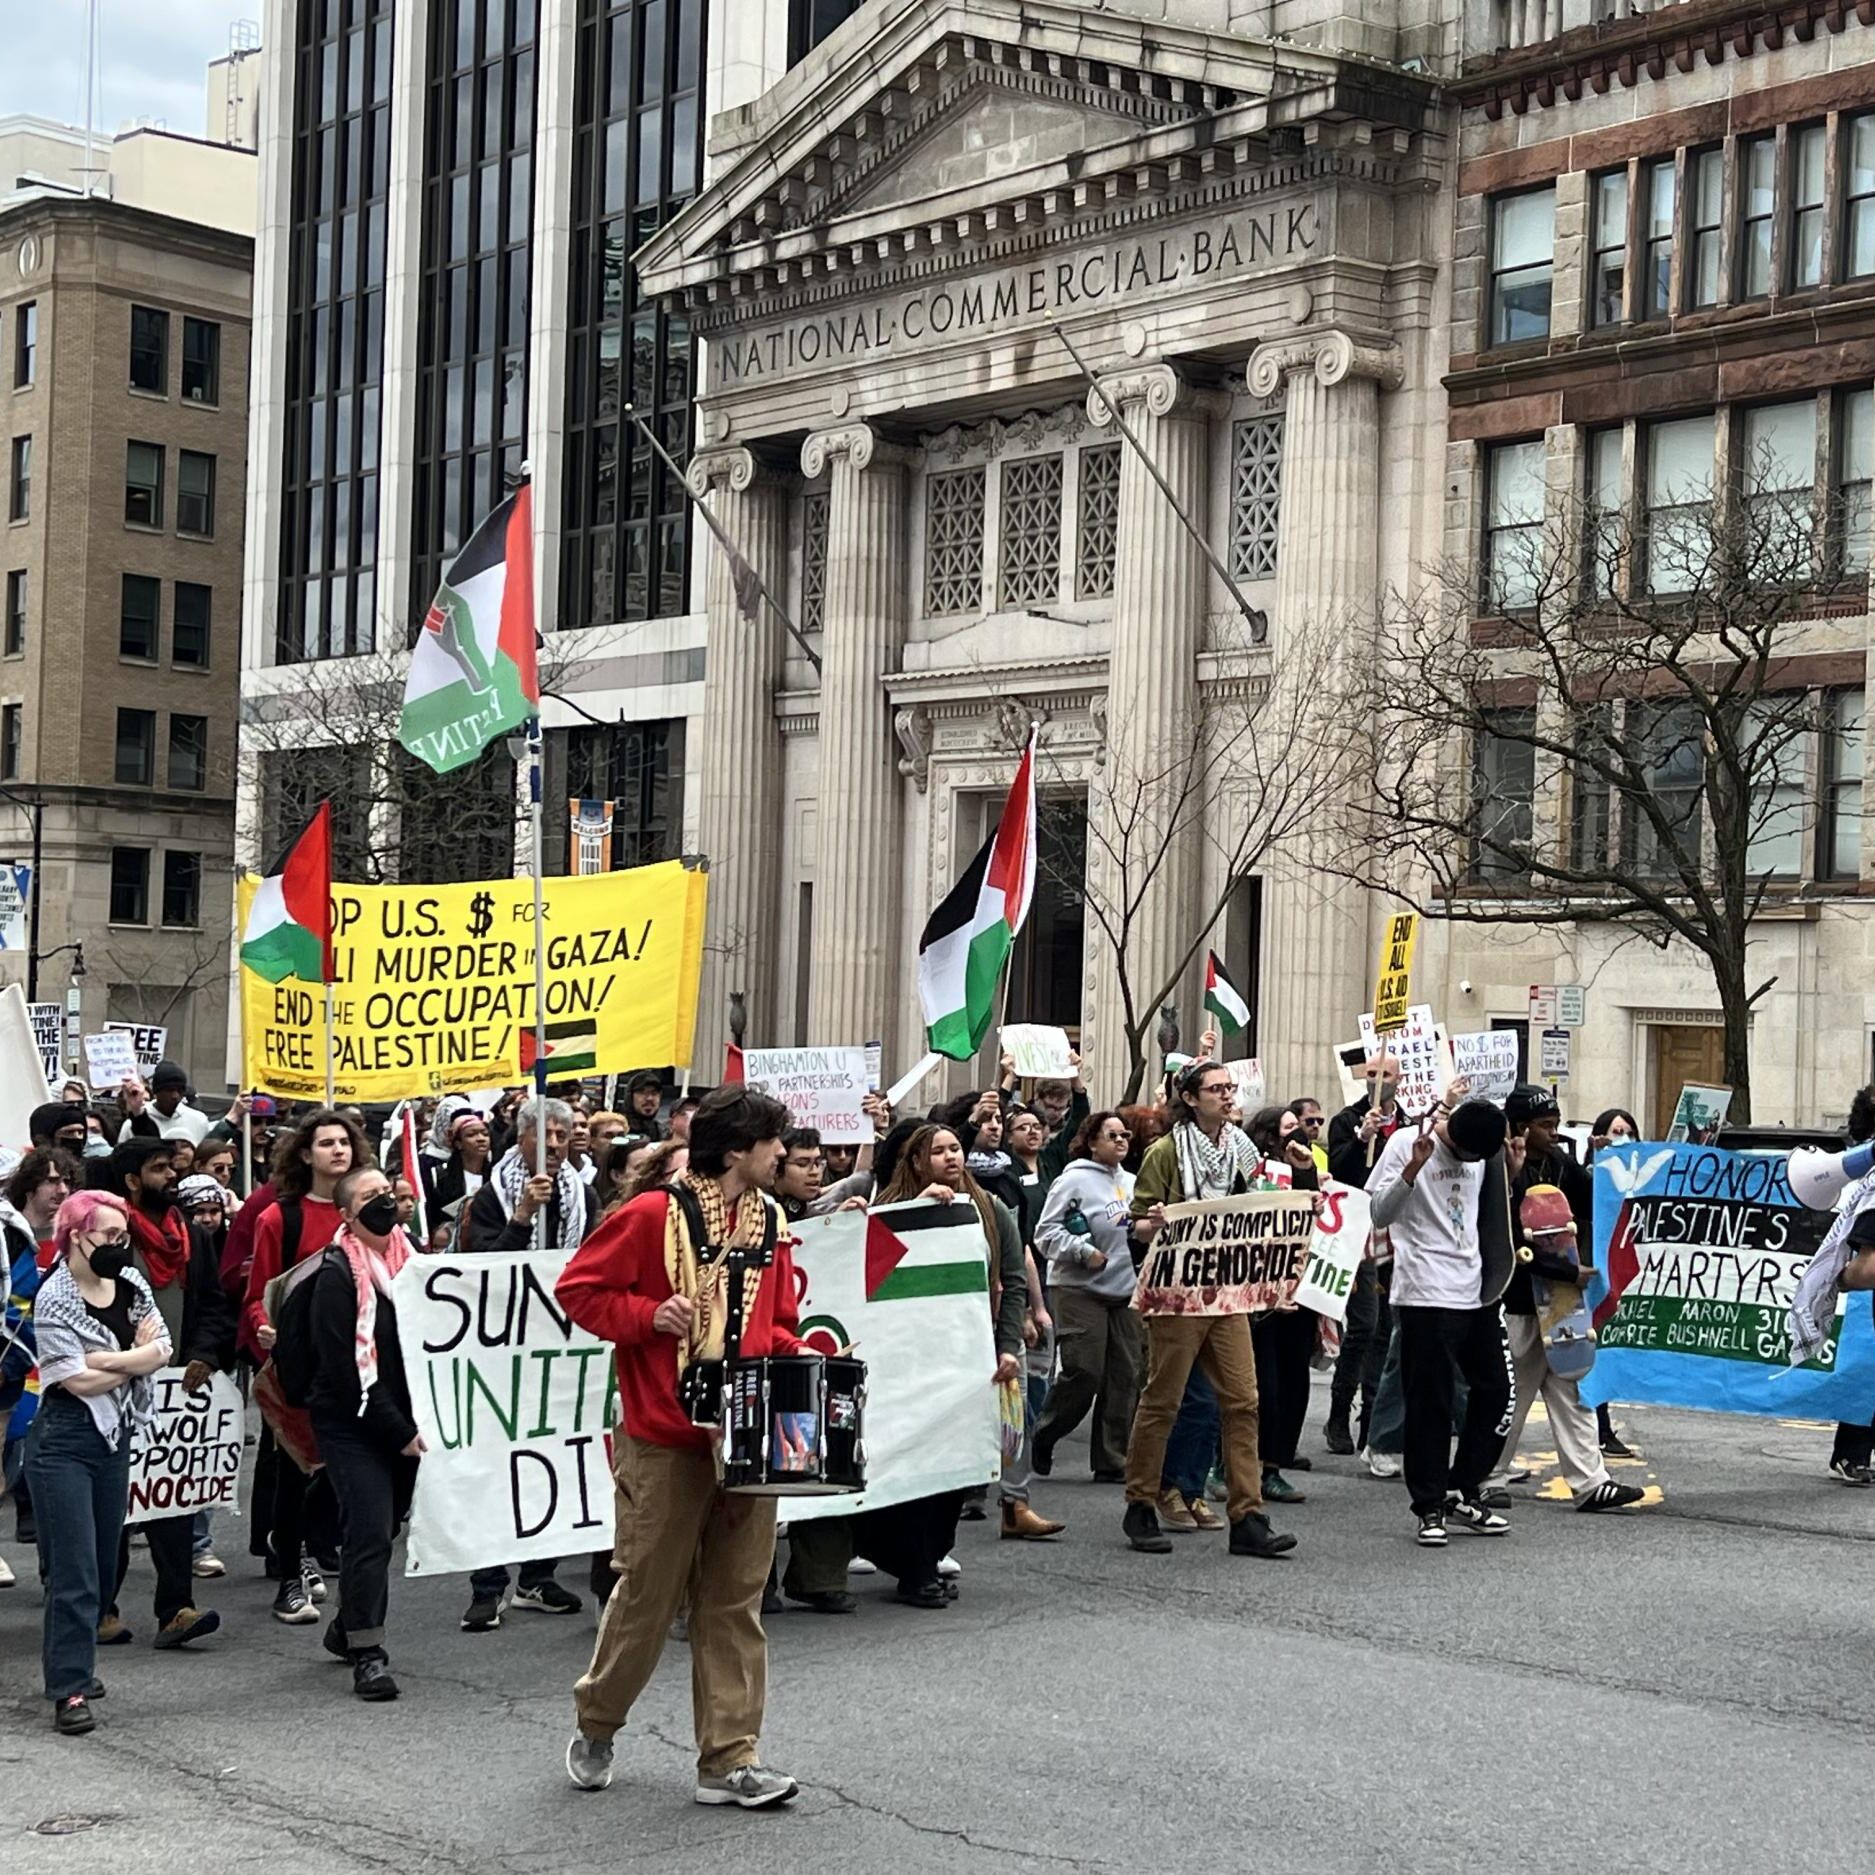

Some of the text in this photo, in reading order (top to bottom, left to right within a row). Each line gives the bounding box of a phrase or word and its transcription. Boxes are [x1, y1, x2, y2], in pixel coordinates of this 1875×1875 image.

[722, 204, 1316, 382] NATIONAL COMMERCIAL BANK
[381, 899, 445, 939] U.S.
[466, 891, 496, 939] $
[513, 902, 550, 922] FOR
[1392, 915, 1412, 943] END
[374, 942, 516, 984] MURDER
[547, 919, 652, 970] GAZA!
[35, 1004, 60, 1016] WITH
[274, 987, 313, 1027] END
[366, 974, 616, 1030] OCCUPATON!
[34, 1029, 60, 1044] THE
[265, 1028, 314, 1070] FREE
[1457, 1038, 1475, 1052] NO
[1493, 1034, 1513, 1049] FOR
[747, 1051, 829, 1077] BINGHAMTON
[778, 1073, 854, 1092] PARTNERSHIPS
[1157, 1215, 1198, 1247] SUNY
[1200, 1213, 1218, 1242] IS
[1221, 1209, 1314, 1240] COMPLICIT
[1619, 1201, 1790, 1251] PALESTINE'S
[1148, 1250, 1176, 1288] IN
[1182, 1242, 1306, 1287] GENOCIDE
[423, 1263, 573, 1354] SUN
[1679, 1301, 1741, 1324] AARON
[1601, 1323, 1658, 1347] CORRIE
[1666, 1323, 1750, 1351] BUSHNELL
[746, 1369, 757, 1396] FREE
[129, 1475, 236, 1517] NOCIDE
